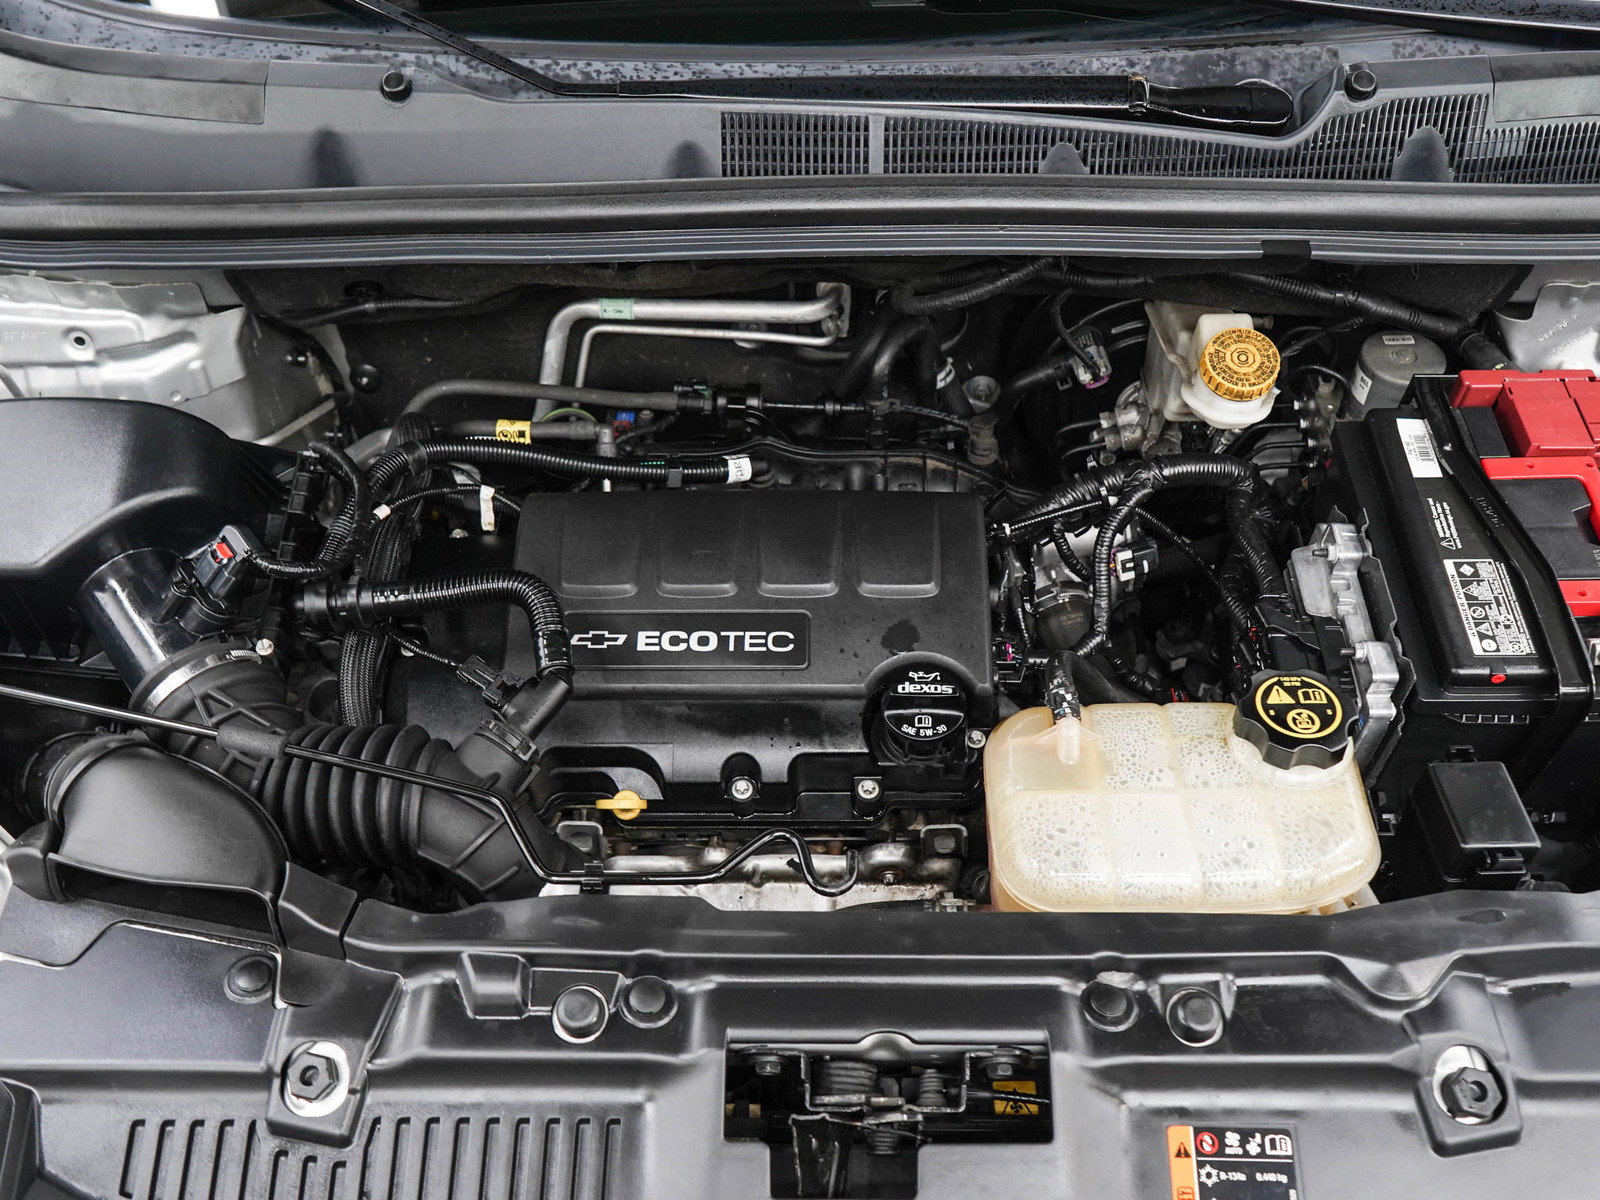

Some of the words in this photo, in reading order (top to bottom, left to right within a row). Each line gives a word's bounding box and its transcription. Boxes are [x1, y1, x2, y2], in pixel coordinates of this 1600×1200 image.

[1450, 574, 1463, 599] POISON
[1460, 602, 1473, 630] DANGER
[636, 630, 795, 652] ECOTEC
[897, 681, 955, 694] dexos
[901, 724, 917, 736] SAE
[919, 724, 948, 737] 5W-30
